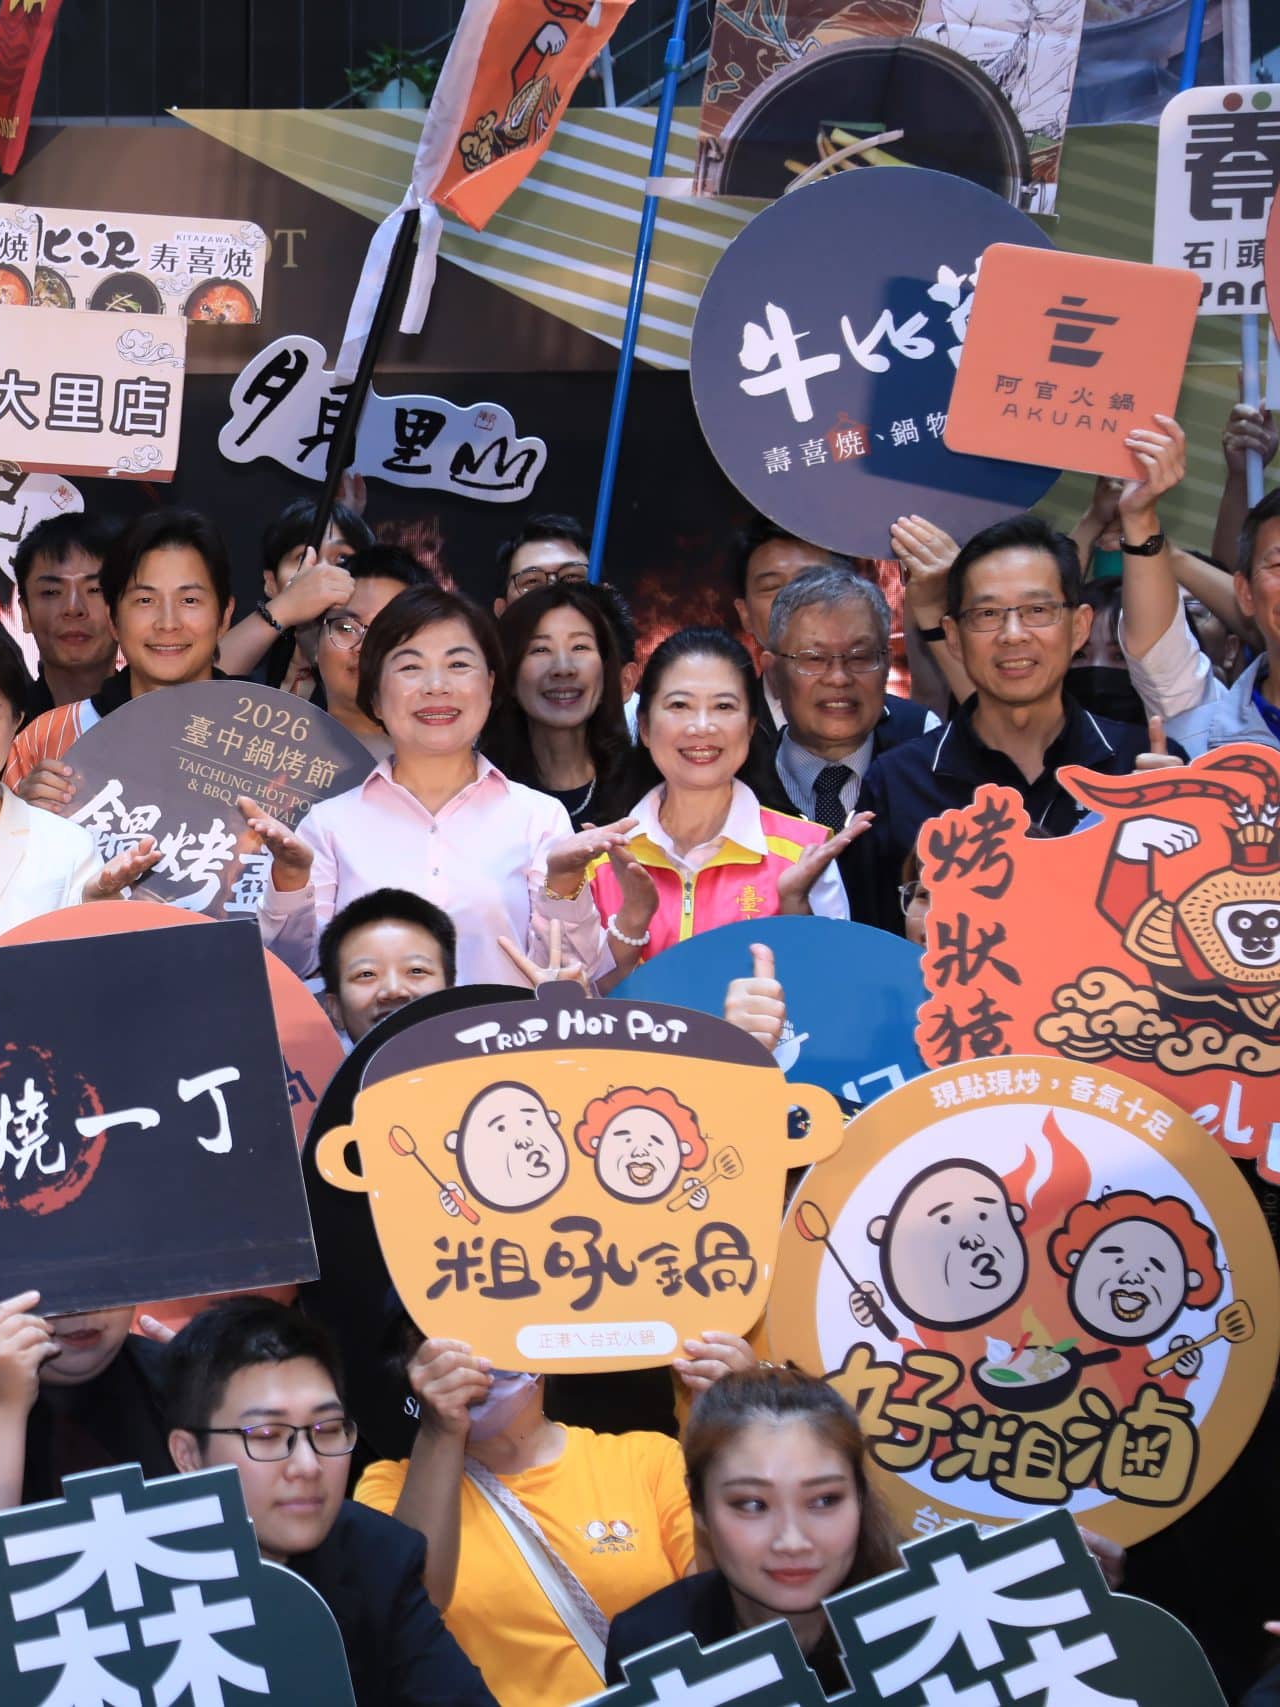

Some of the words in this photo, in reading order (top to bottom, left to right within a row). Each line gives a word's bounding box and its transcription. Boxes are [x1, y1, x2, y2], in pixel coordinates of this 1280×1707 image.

[994, 374, 1136, 412] 阿官火鍋
[1002, 403, 1118, 433] AKUAN
[233, 697, 311, 742] 2026
[181, 715, 340, 790] 臺中鍋烤節
[178, 756, 252, 792] TAICHUNG
[255, 784, 288, 804] HOT
[289, 795, 312, 812] PO
[187, 777, 199, 792] &
[202, 782, 236, 808] BBQ
[426, 1215, 757, 1311] 粗吼鍋
